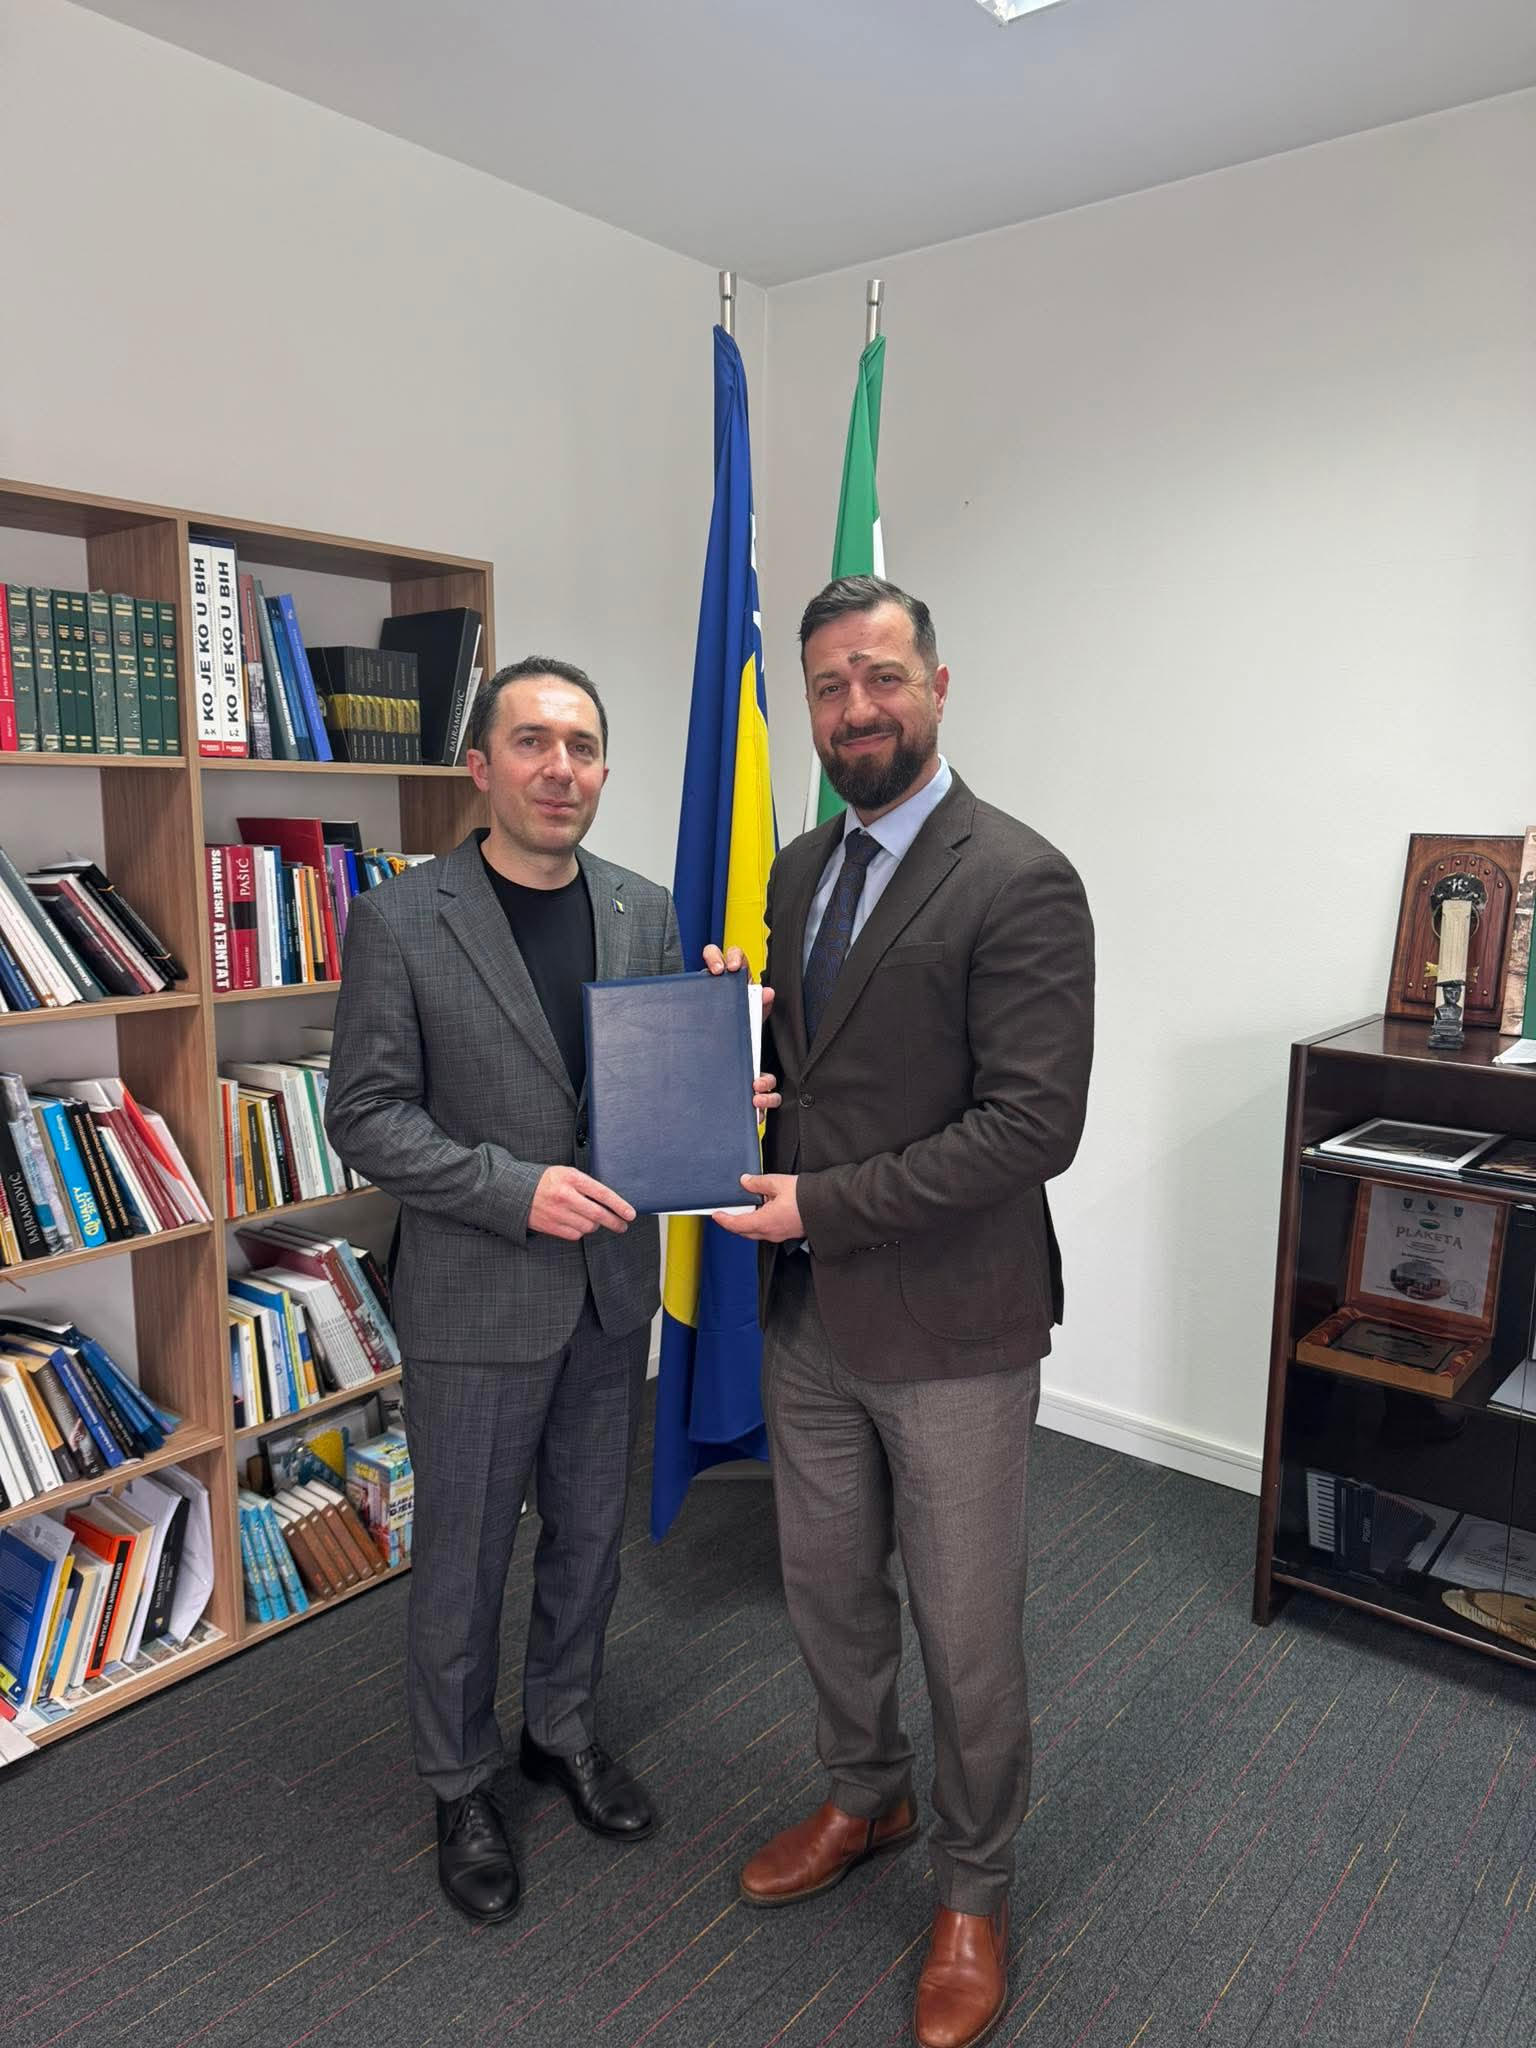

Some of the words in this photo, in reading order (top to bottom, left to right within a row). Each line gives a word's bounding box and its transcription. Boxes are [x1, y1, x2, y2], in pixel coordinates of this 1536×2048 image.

[194, 558, 206, 595] BIH
[218, 561, 230, 598] BIH
[197, 602, 208, 616] U
[220, 605, 232, 619] U
[198, 624, 210, 654] KO
[222, 627, 235, 656] KO
[200, 659, 212, 686] JE
[225, 663, 236, 688] JE
[201, 692, 214, 721] KO
[226, 694, 239, 723] KO
[204, 727, 217, 736] A-K
[211, 849, 225, 918] SARAJEVSKI
[236, 857, 251, 896] PAŠIĆ
[213, 921, 229, 989] ATENTAT
[73, 1187, 100, 1236] QUALITY
[1396, 1226, 1464, 1250] PLAKETA
